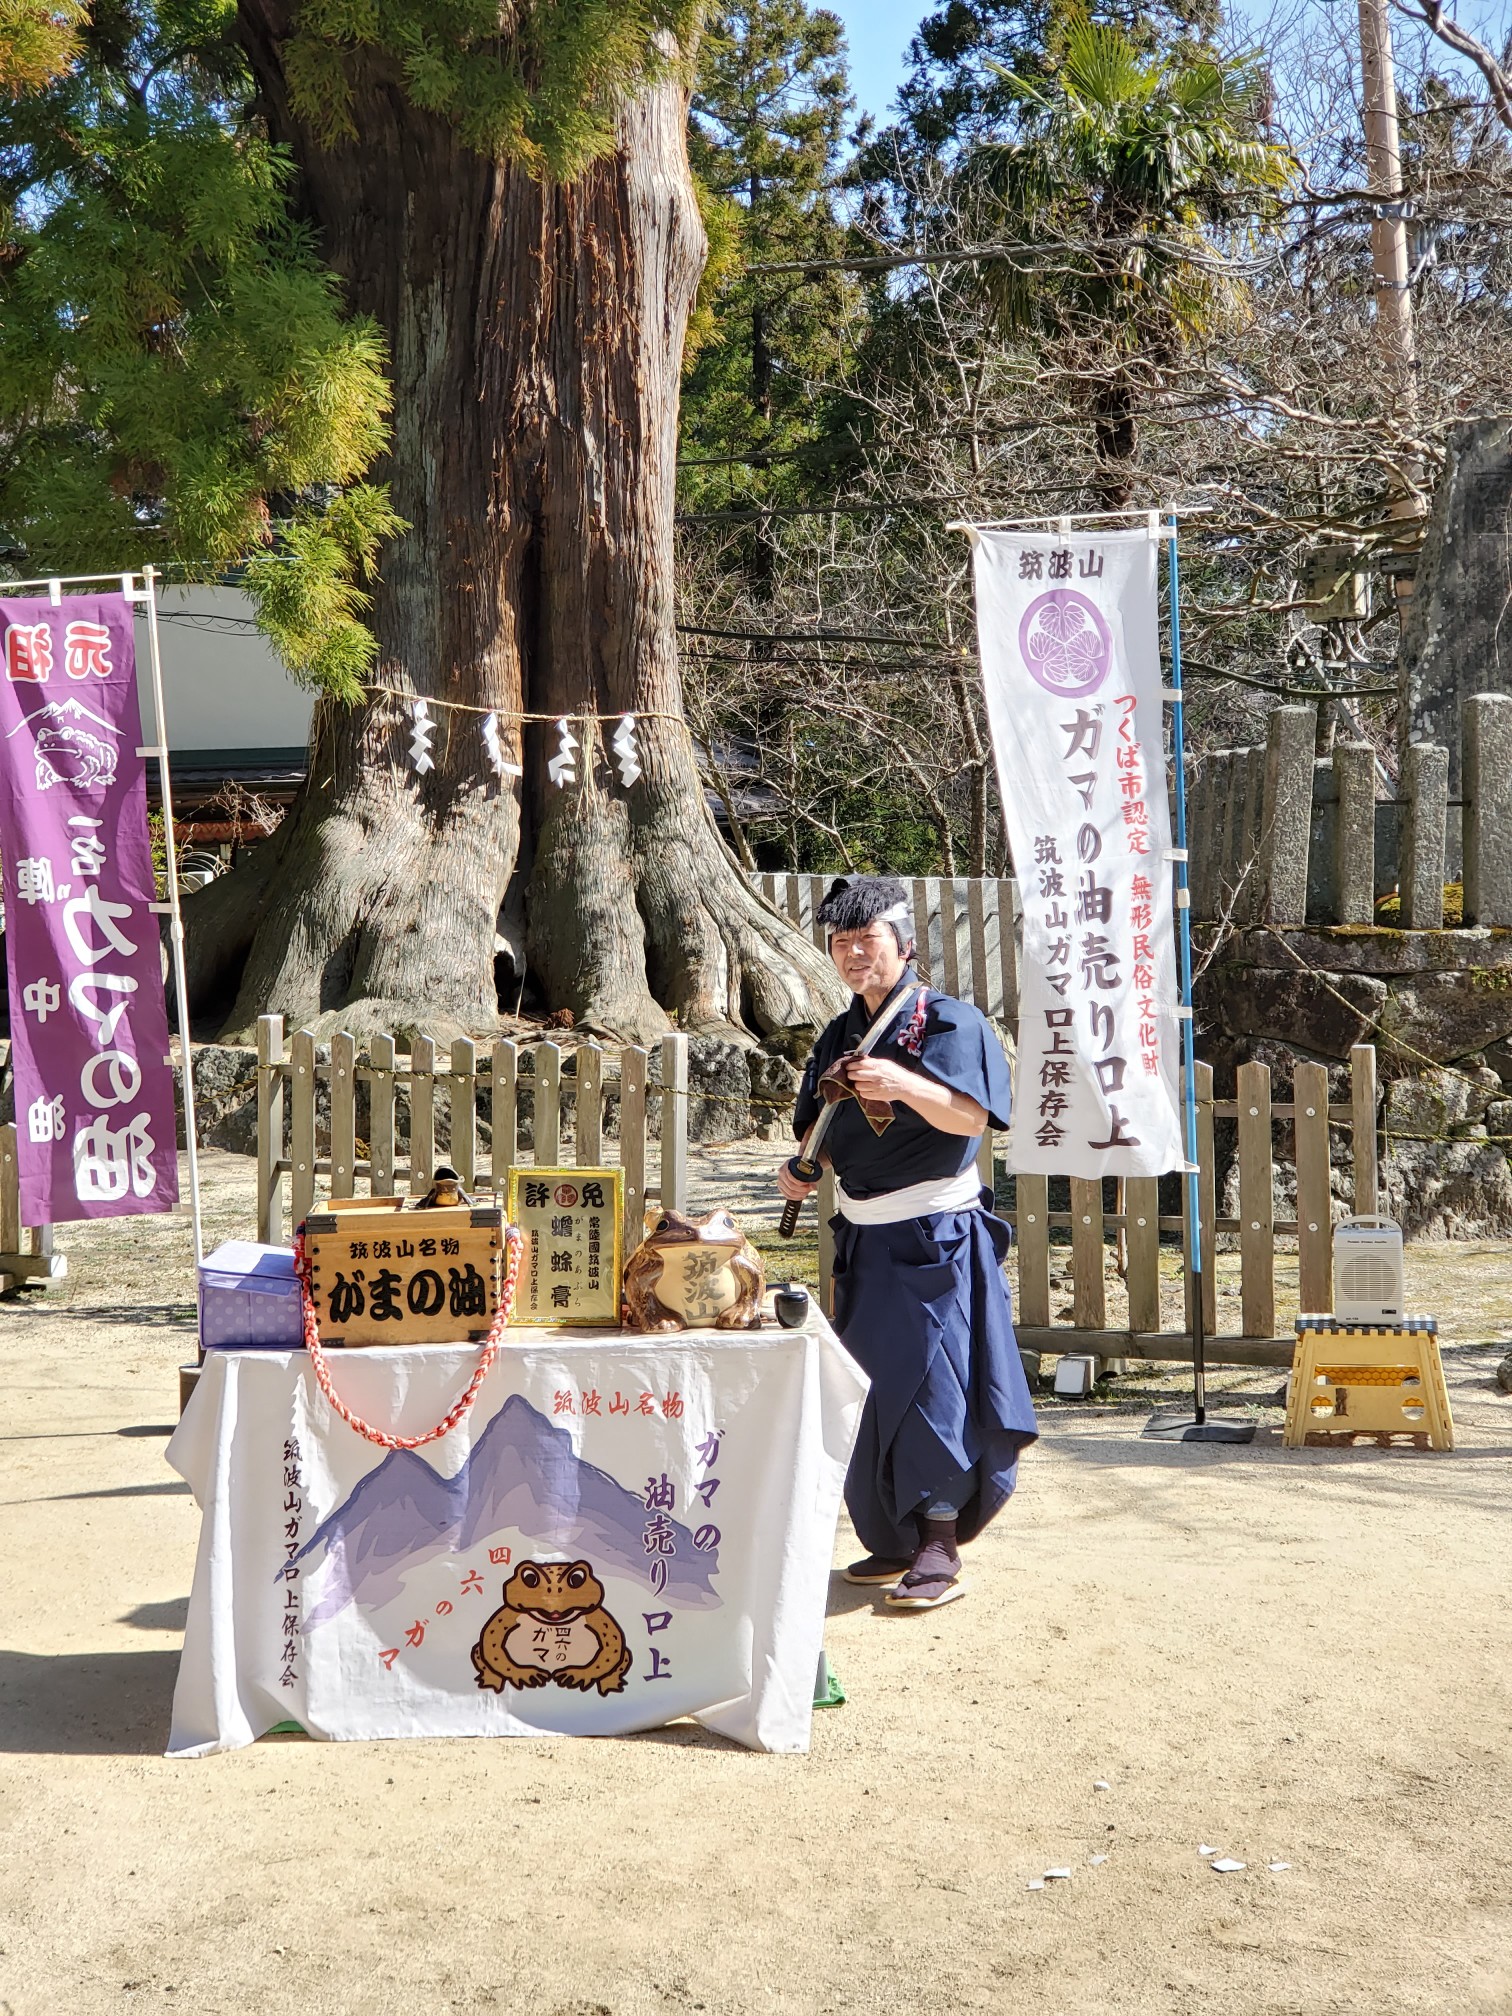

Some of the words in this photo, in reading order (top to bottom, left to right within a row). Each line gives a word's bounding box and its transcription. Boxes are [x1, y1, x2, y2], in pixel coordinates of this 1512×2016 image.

[1018, 549, 1104, 580] 筑波山
[1112, 694, 1151, 855] つくば市認定
[1059, 703, 1141, 1150] ガマの油売り口上
[1033, 835, 1078, 1148] 筑波山ガマ口上保存会
[1128, 873, 1159, 1078] 無形民俗文化財
[349, 1237, 460, 1260] 筑波山名物
[327, 1262, 487, 1324] がまの油
[682, 1251, 726, 1320] 筑波山
[553, 1389, 686, 1419] 筑波山名物
[278, 1439, 304, 1690] 筑波山ガマ口上保存会
[532, 1626, 553, 1663] ガマ
